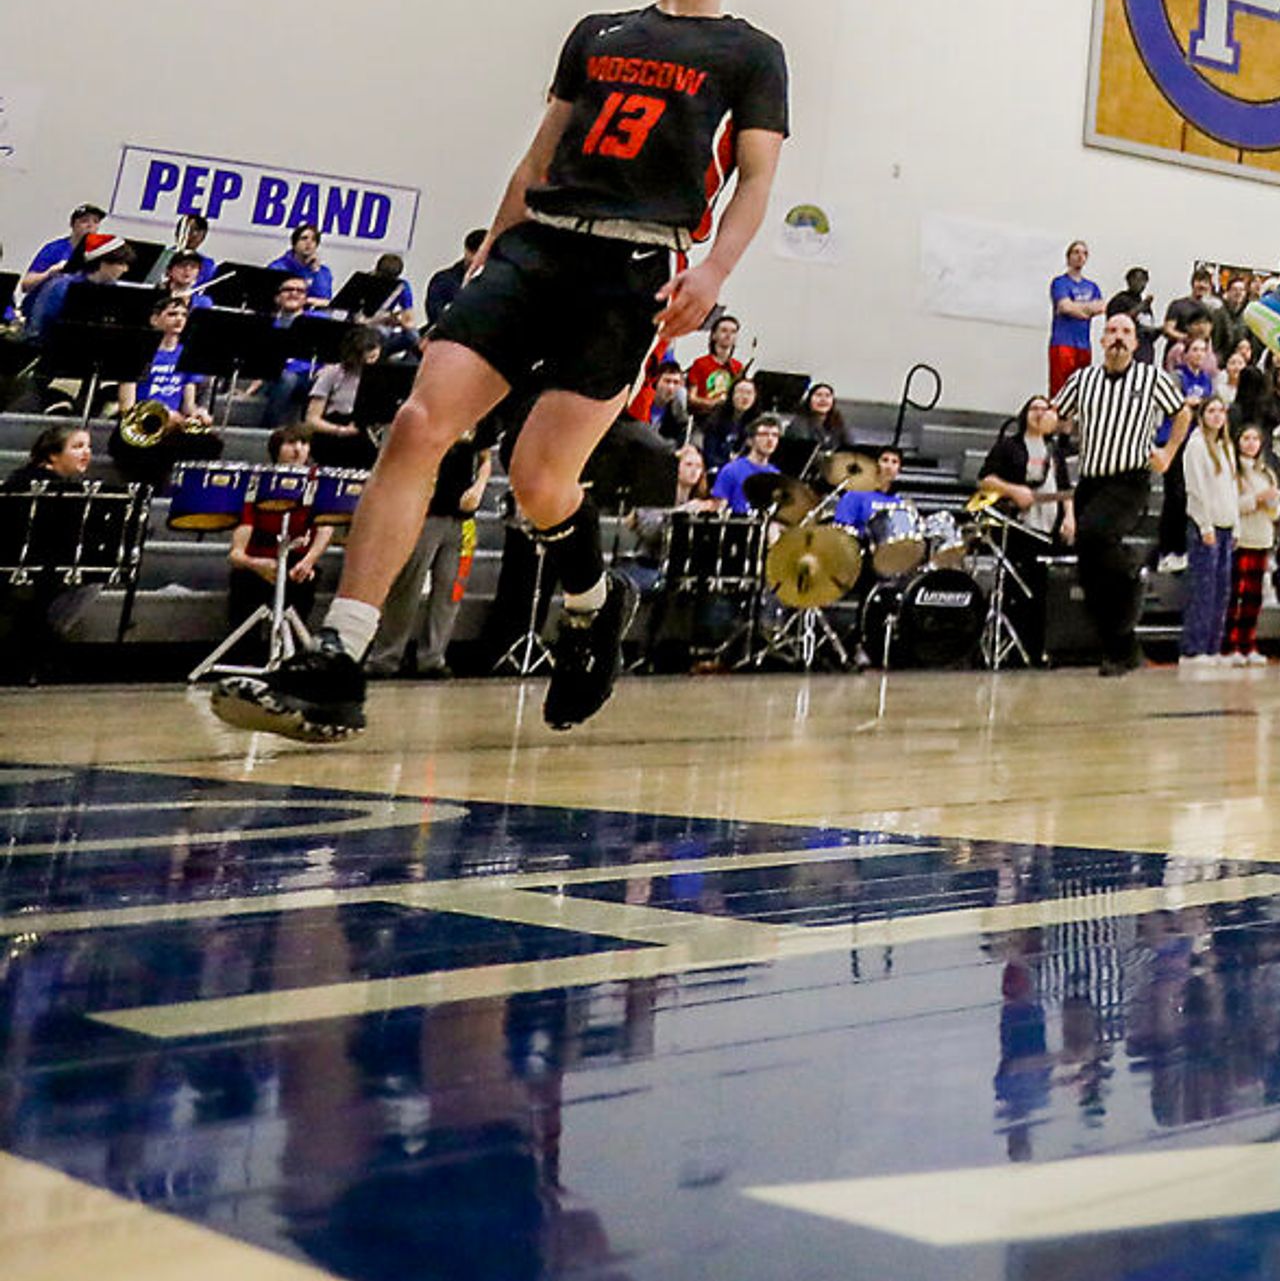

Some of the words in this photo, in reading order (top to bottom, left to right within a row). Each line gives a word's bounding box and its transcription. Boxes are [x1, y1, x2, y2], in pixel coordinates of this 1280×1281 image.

[587, 55, 709, 96] MOSCOW
[582, 91, 667, 160] 13
[140, 159, 243, 219] PEP
[252, 183, 394, 241] BAND
